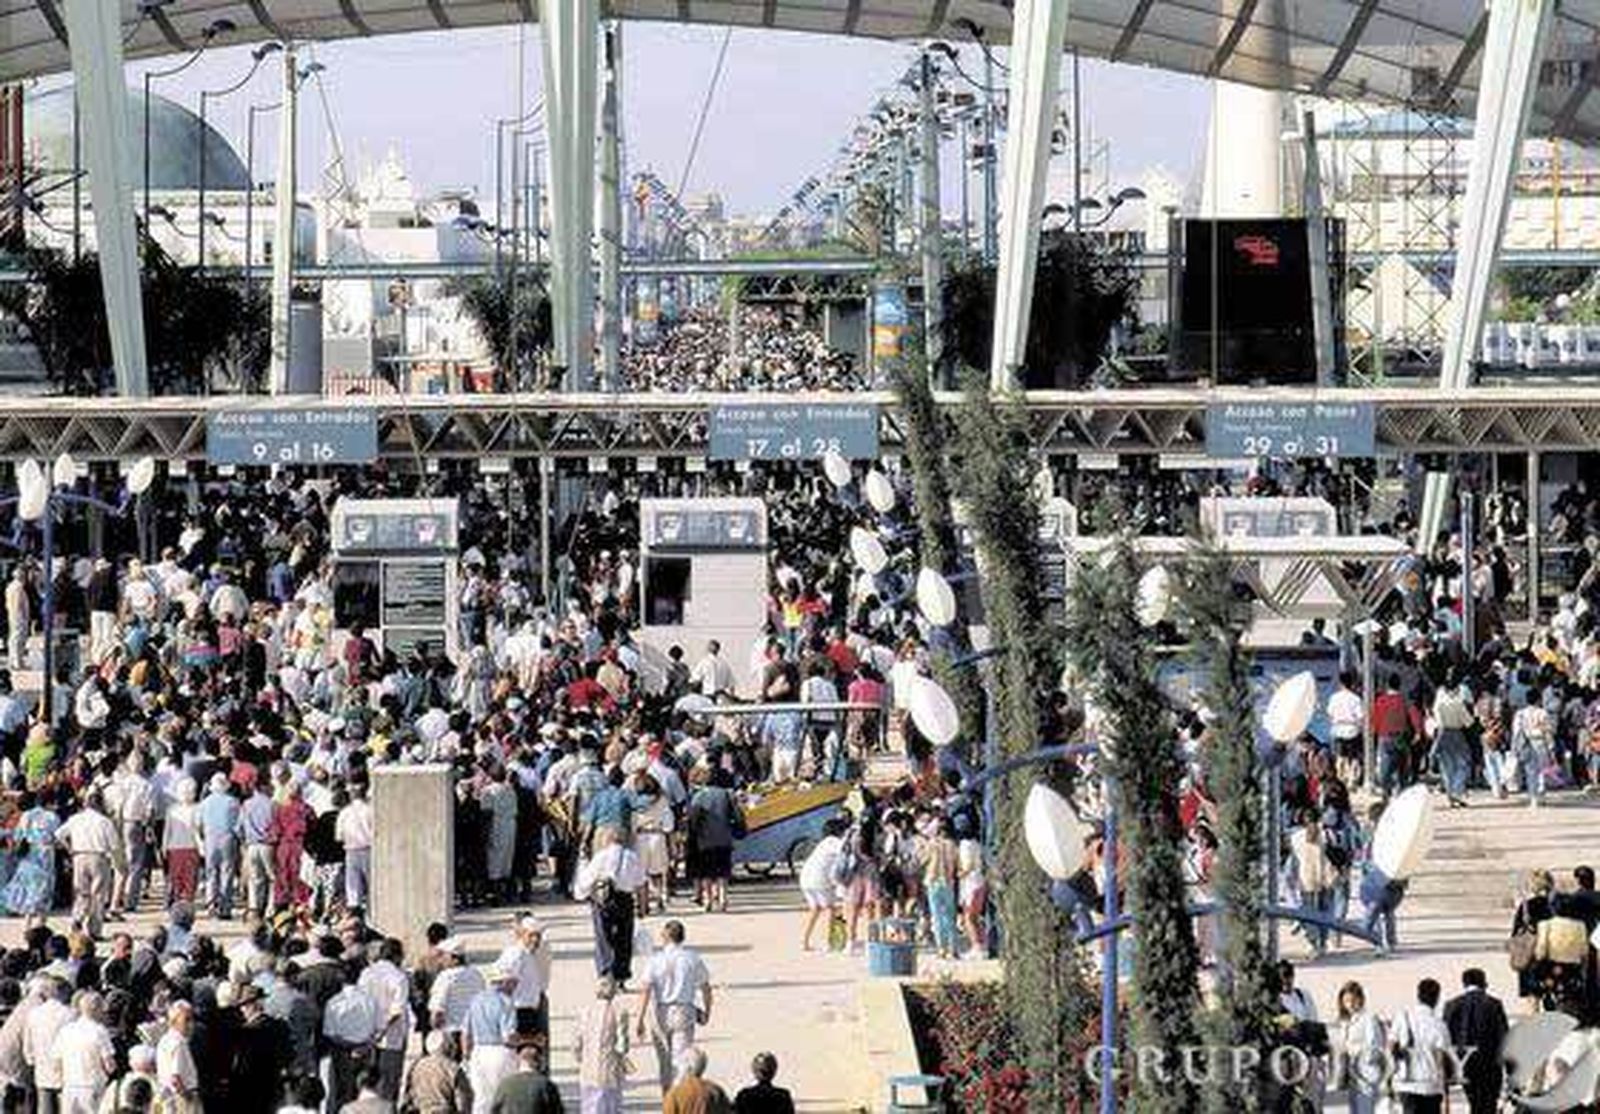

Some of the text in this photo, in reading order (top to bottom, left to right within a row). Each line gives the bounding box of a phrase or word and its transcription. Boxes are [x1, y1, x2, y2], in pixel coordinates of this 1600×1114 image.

[1282, 407, 1307, 418] con
[253, 442, 335, 462] 9 al 16
[747, 438, 841, 457] 17 al 28
[1243, 435, 1339, 455] 29 al 31
